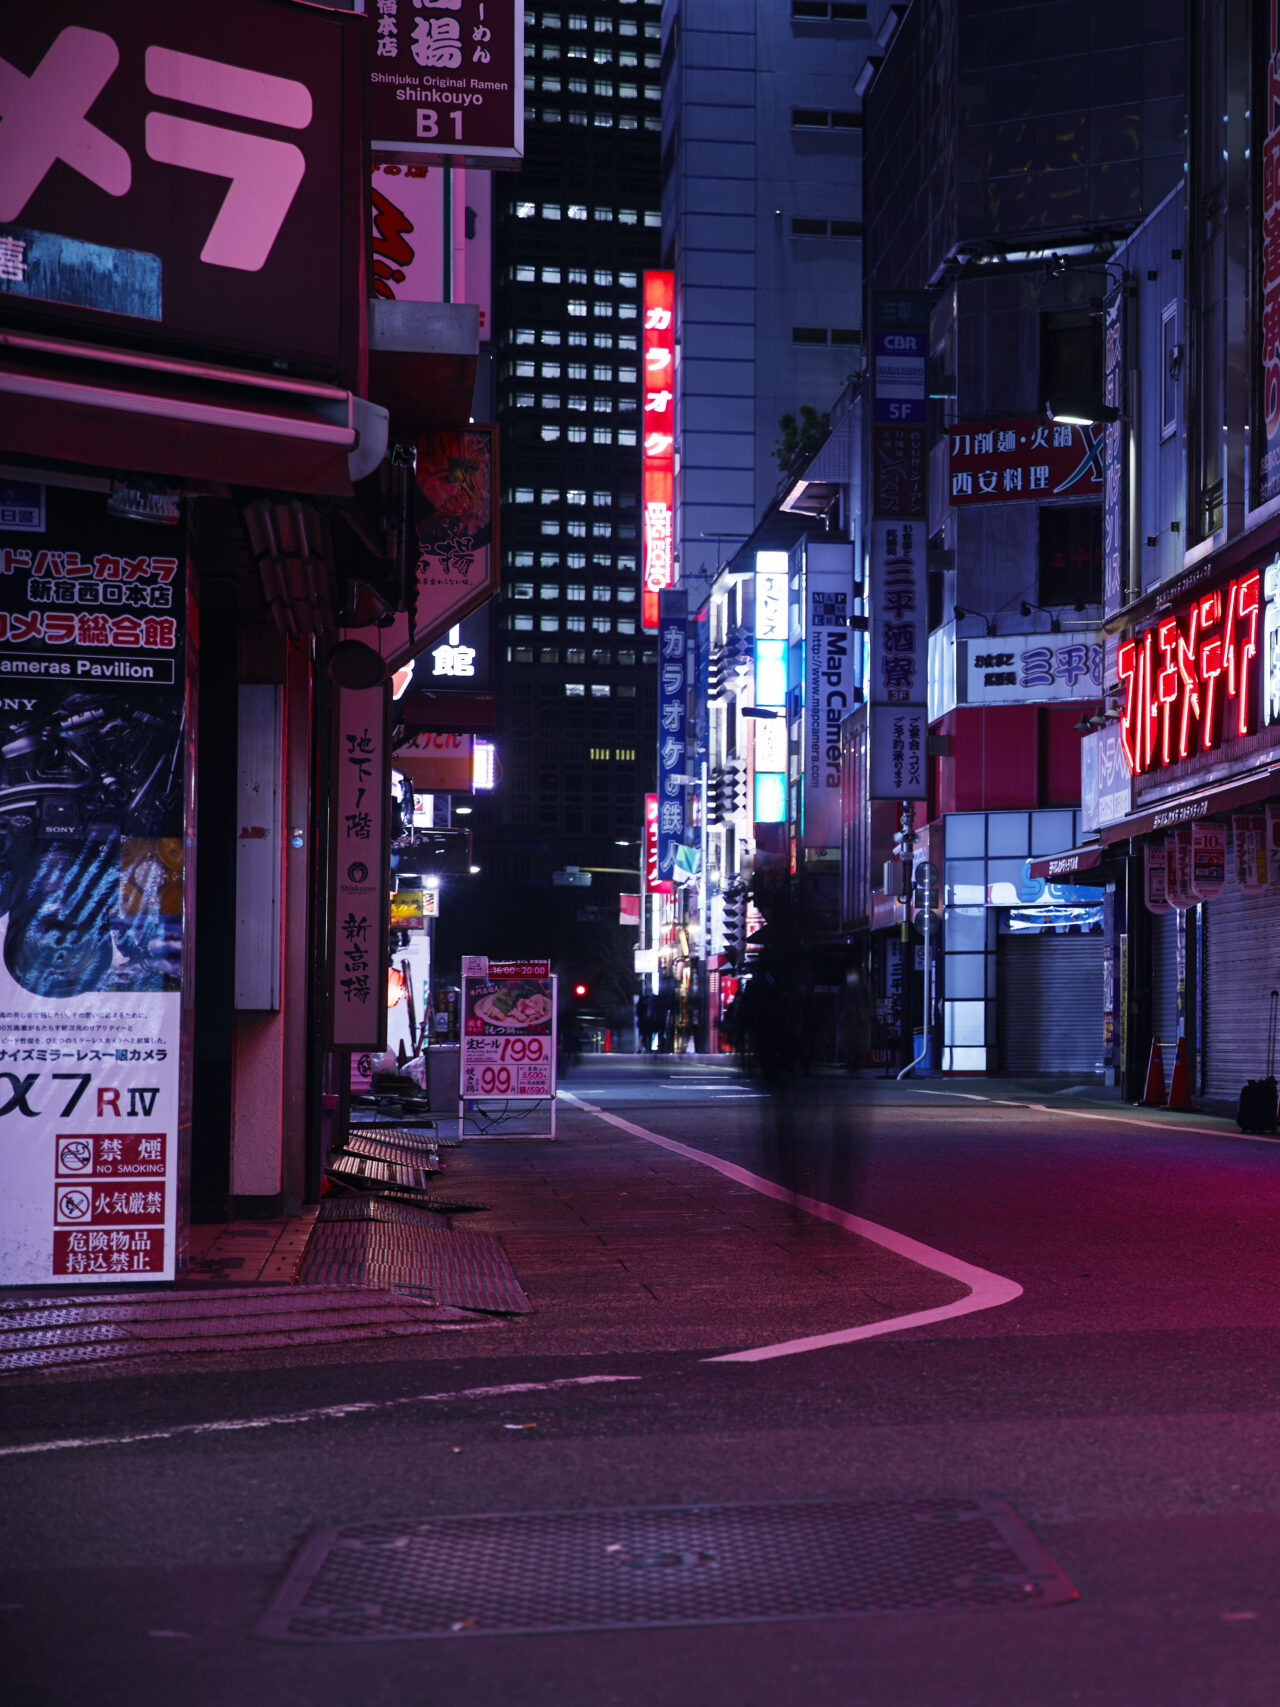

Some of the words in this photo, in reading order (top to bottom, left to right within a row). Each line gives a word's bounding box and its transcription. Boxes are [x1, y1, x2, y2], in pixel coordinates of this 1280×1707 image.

[370, 72, 420, 87] Shinjuku
[423, 75, 467, 90] Original
[470, 79, 509, 92] Ramen
[396, 87, 484, 107] shinkouyo
[0, 25, 313, 271] メラ
[883, 336, 918, 350] CBR
[645, 307, 672, 456] カラオケ
[889, 404, 913, 419] 5F
[951, 425, 1073, 457] 刀削麺・火鍋
[951, 465, 1050, 496] 西安料理
[646, 502, 667, 543] BIG
[0, 548, 179, 584] ドバシカメラ
[647, 544, 668, 592] ECHO
[27, 577, 174, 609] 新宿西口本店
[76, 660, 155, 679] Pavilion
[821, 632, 848, 687] Map
[825, 690, 848, 789] Camera
[481, 1066, 511, 1094] 99
[96, 1165, 113, 1174] NO
[117, 1164, 165, 1174] SMOKING
[94, 1191, 163, 1216] 火気厳禁
[66, 1231, 152, 1253] 危険物品
[65, 1252, 152, 1273] 持込禁止
